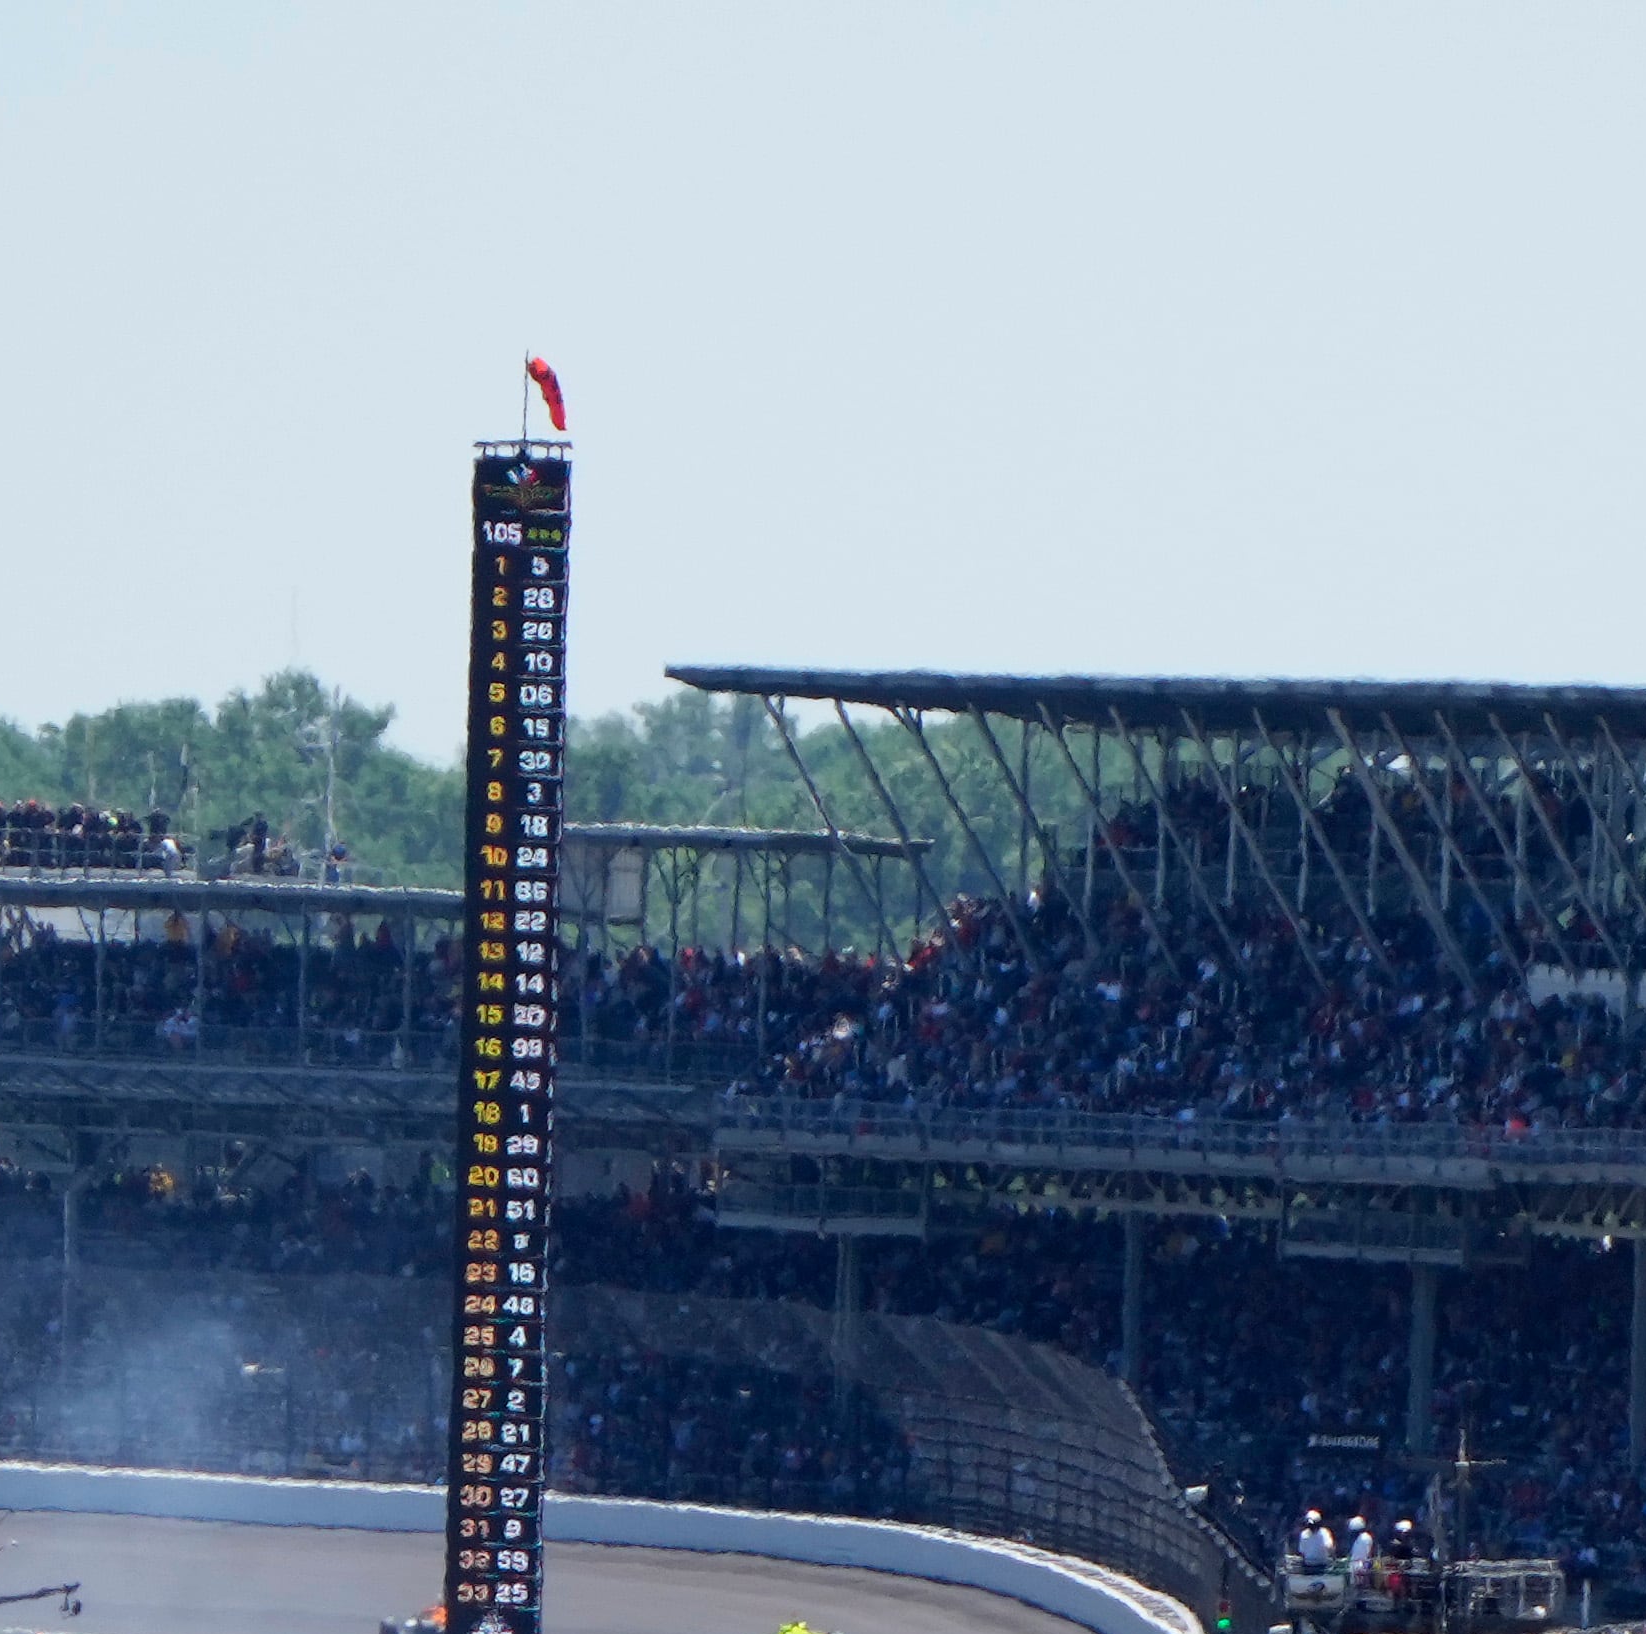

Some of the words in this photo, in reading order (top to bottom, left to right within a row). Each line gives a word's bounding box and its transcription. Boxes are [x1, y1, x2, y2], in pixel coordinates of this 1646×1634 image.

[482, 520, 523, 547] 105
[495, 555, 507, 576] 1
[523, 588, 554, 608] 28
[491, 652, 505, 670] 4
[525, 652, 553, 672] 10
[489, 682, 506, 702] 5
[519, 685, 553, 706] 06
[489, 716, 506, 736] 6
[487, 749, 503, 768] 7
[519, 751, 551, 770] 30
[487, 782, 503, 800] 8
[527, 783, 541, 803] 3
[521, 814, 548, 837] 18
[481, 846, 507, 866] 10
[517, 847, 548, 867] 24
[481, 880, 505, 900] 11
[515, 912, 547, 931] 22
[515, 942, 545, 962] 12
[477, 972, 503, 991] 14
[515, 974, 544, 994] 14
[477, 1004, 503, 1024] 15
[475, 1038, 501, 1059] 16
[473, 1069, 501, 1090] 17
[510, 1070, 541, 1091] 45
[521, 1104, 529, 1123] 1
[473, 1134, 499, 1152] 19
[468, 1166, 499, 1186] 20
[469, 1198, 497, 1218] 21
[507, 1200, 535, 1220] 51
[467, 1230, 499, 1250] 22
[509, 1262, 535, 1284] 16
[463, 1326, 495, 1346] 25
[509, 1326, 526, 1348] 4
[507, 1358, 523, 1378] 7
[463, 1388, 491, 1409] 27
[507, 1391, 526, 1411] 2
[501, 1422, 530, 1443] 21
[501, 1454, 531, 1472] 47
[460, 1484, 492, 1506] 30
[500, 1487, 528, 1508] 27
[460, 1518, 489, 1538] 31
[497, 1551, 528, 1572] 59
[495, 1582, 528, 1602] 25
